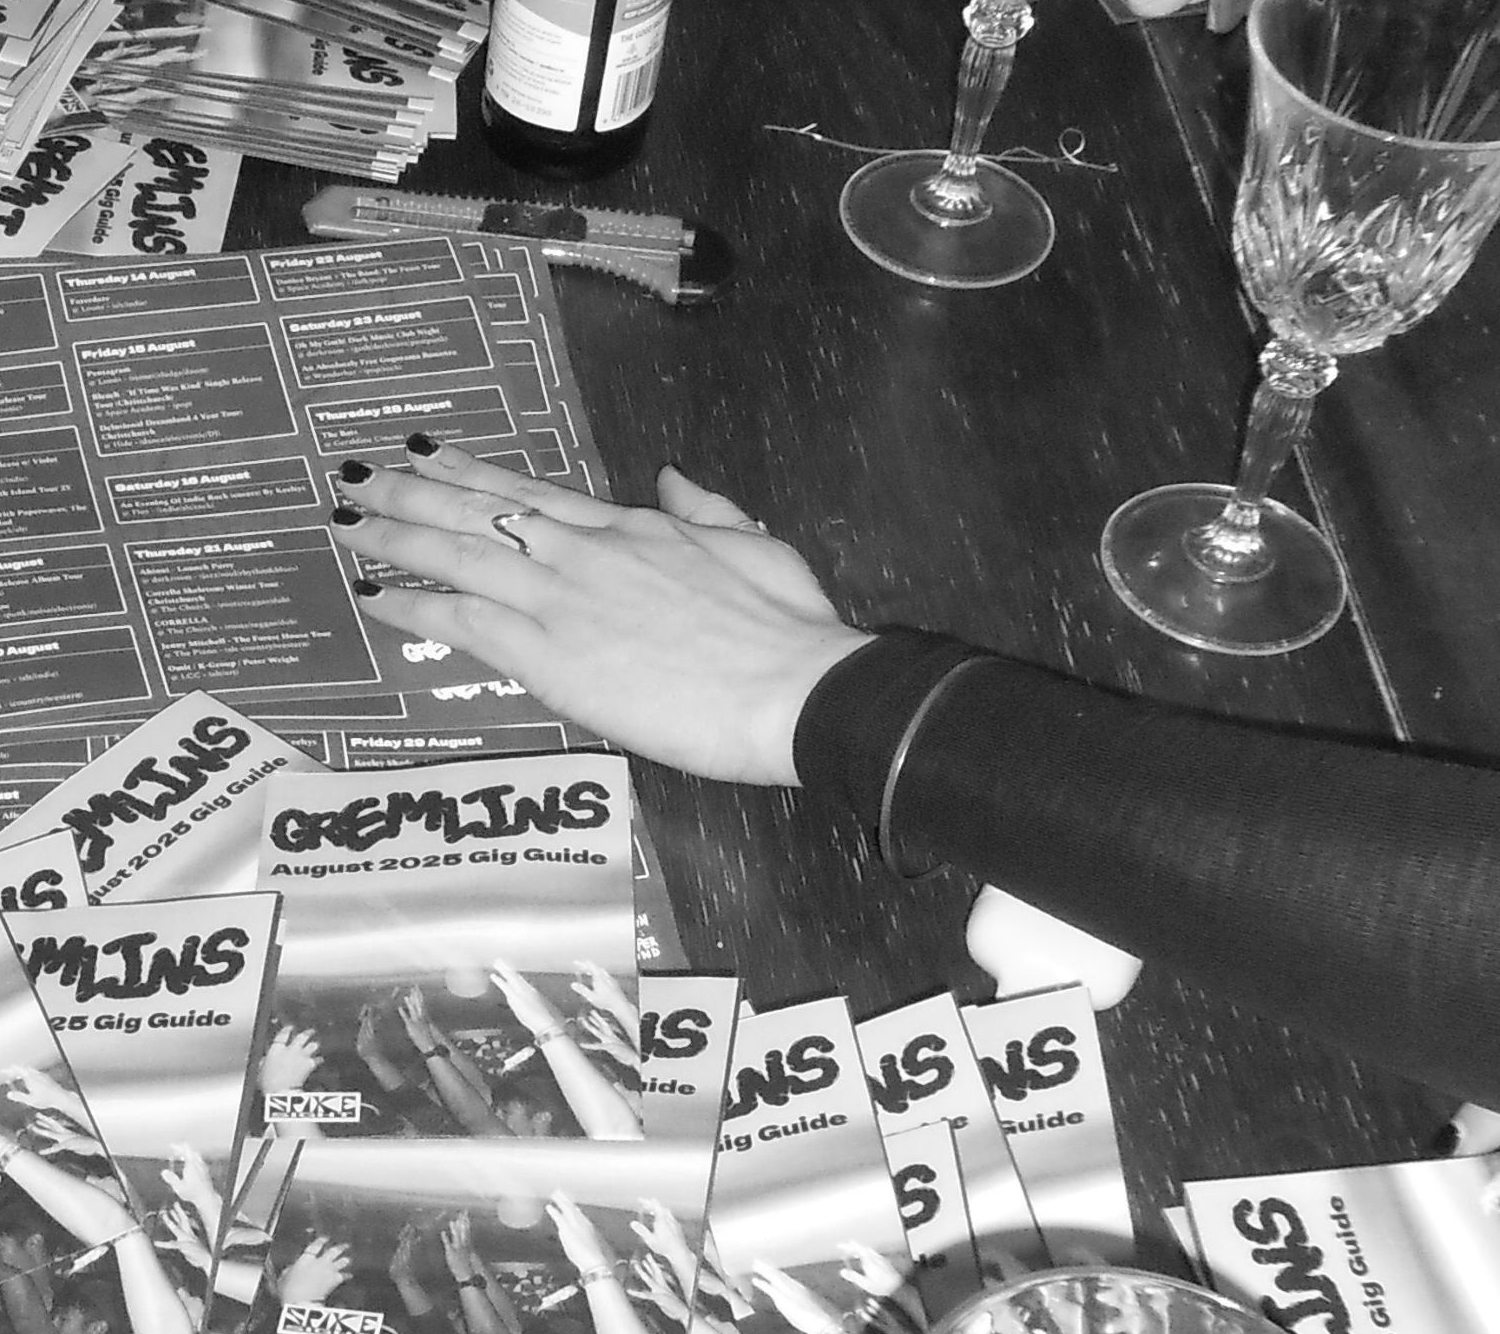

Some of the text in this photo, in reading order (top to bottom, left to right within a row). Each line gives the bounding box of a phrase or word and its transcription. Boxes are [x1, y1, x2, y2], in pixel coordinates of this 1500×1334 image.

[91, 189, 120, 245] Gig Guide
[270, 256, 315, 269] Friday
[336, 251, 383, 264] August
[65, 268, 196, 288] Thursday 14 August
[289, 311, 422, 333] Saturday 23 August
[81, 348, 127, 360] Friday
[148, 339, 196, 353] August
[315, 405, 381, 422] Thursday
[404, 400, 453, 413] August
[114, 479, 180, 493] Saturday
[200, 470, 251, 485] August
[133, 539, 274, 561] Thursday 21 August
[154, 616, 210, 628] CORRELLA
[7, 642, 60, 656] August
[350, 737, 402, 749] Friday
[428, 735, 483, 748] August
[269, 781, 613, 854] GREMLINS
[269, 846, 610, 879] August 2025 Gig Guide
[1329, 1195, 1369, 1277] Guide
[1361, 1281, 1390, 1328] Gig
